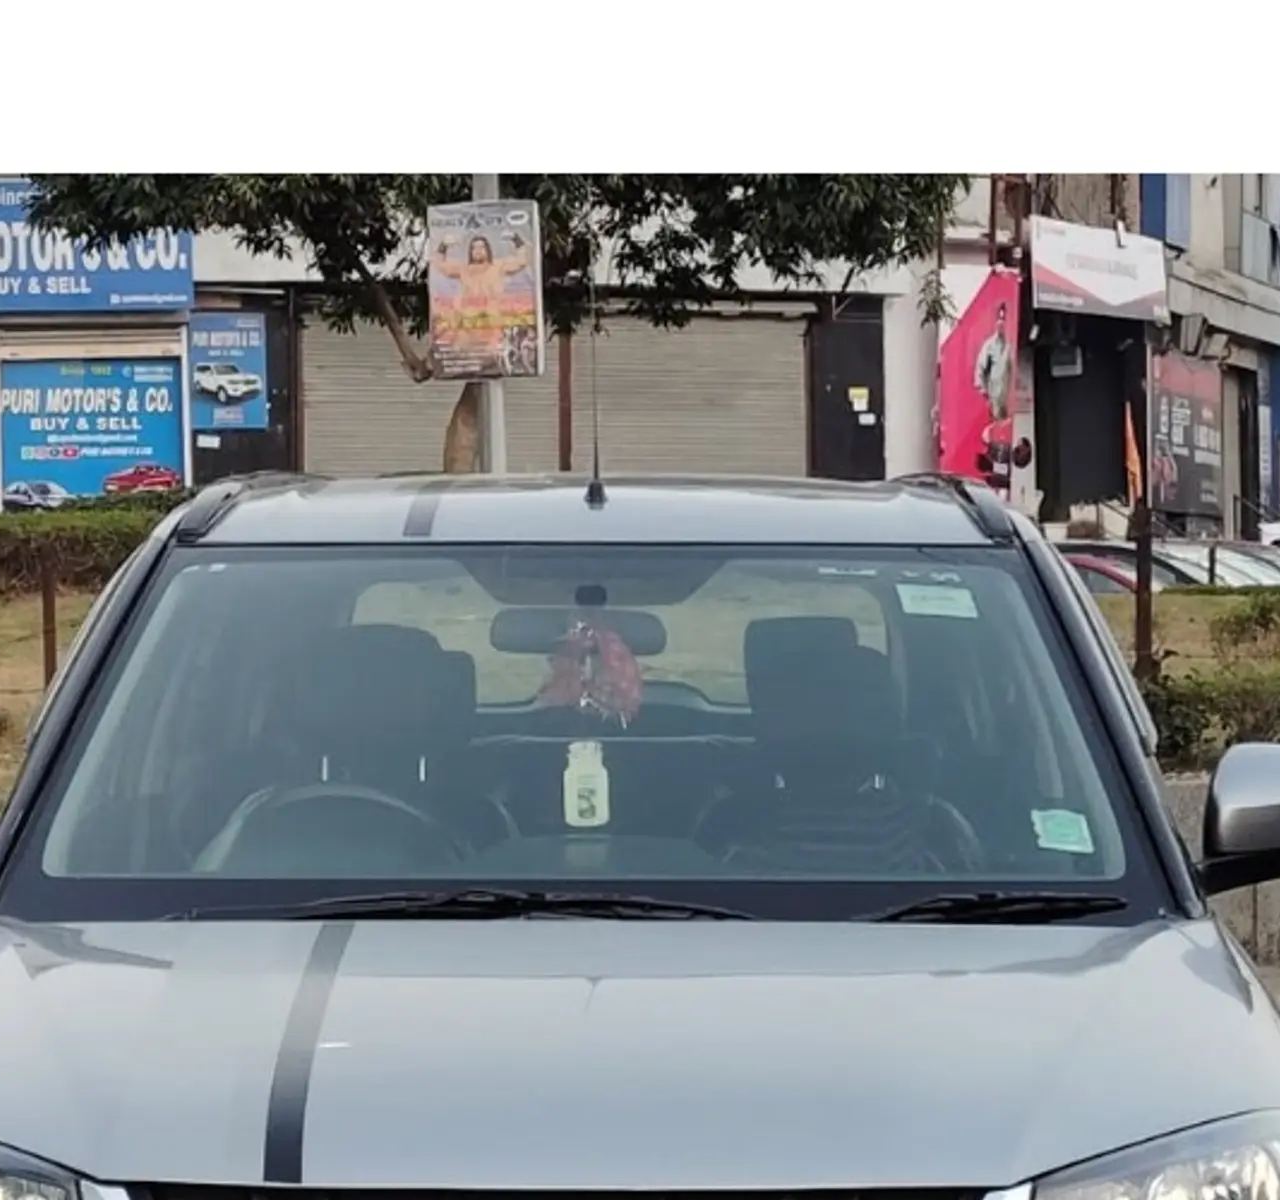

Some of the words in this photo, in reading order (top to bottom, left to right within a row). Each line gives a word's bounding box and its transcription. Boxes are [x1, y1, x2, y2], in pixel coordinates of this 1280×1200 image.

[27, 277, 41, 294] &
[46, 276, 92, 294] SELL
[45, 388, 122, 413] MOTOR'S
[126, 388, 139, 412] &
[145, 386, 173, 412] CO.
[30, 417, 70, 431] BUY
[76, 417, 89, 431] &
[96, 417, 142, 431] SELL
